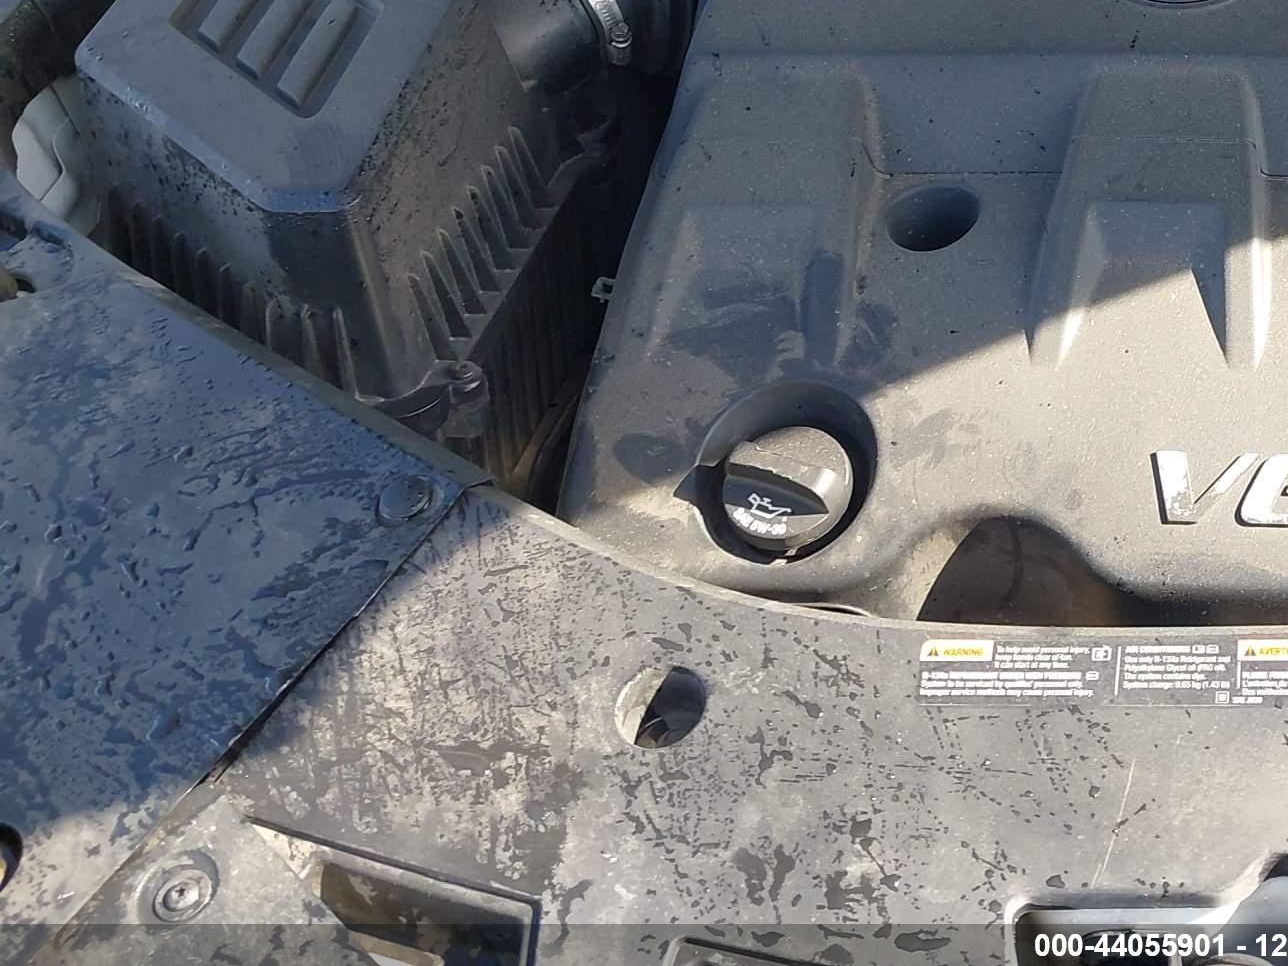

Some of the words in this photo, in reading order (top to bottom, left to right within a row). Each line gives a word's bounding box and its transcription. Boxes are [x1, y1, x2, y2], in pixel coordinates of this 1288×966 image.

[732, 507, 753, 528] SAE
[750, 521, 787, 535] 5W-30
[943, 648, 983, 656] WARNING
